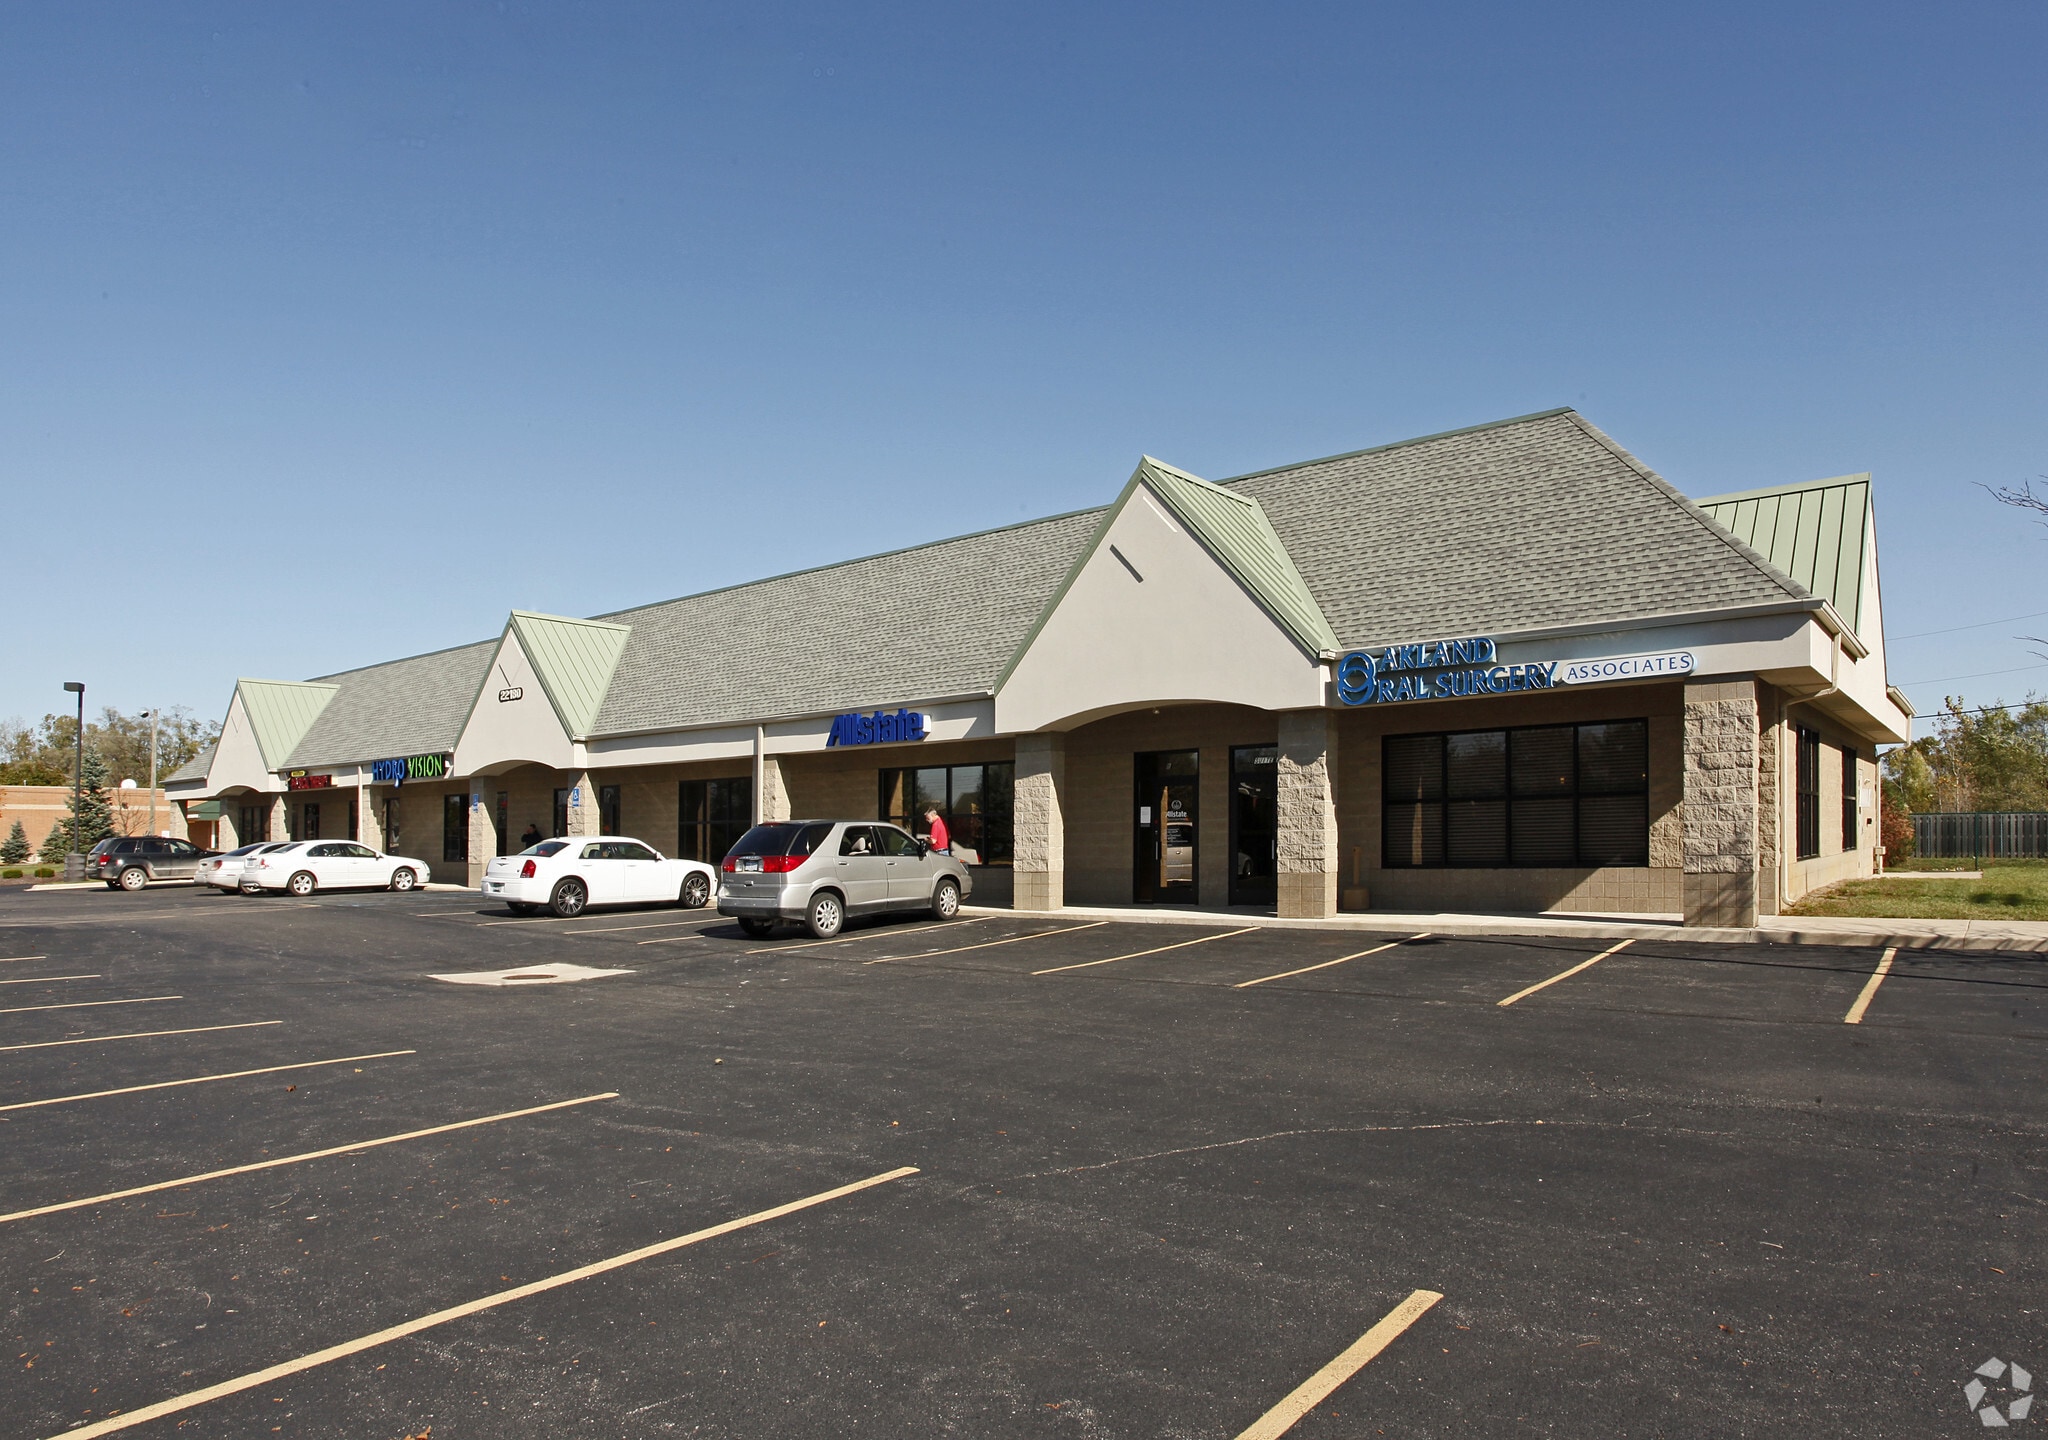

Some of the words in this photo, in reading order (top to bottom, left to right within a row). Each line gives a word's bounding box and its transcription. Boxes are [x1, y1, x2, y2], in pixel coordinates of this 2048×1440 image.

[1435, 661, 1558, 698] SURGERY
[1567, 655, 1690, 680] ASSOCIATES
[826, 708, 924, 747] Allstate
[372, 758, 405, 781] HYDRO
[408, 754, 442, 778] VISION
